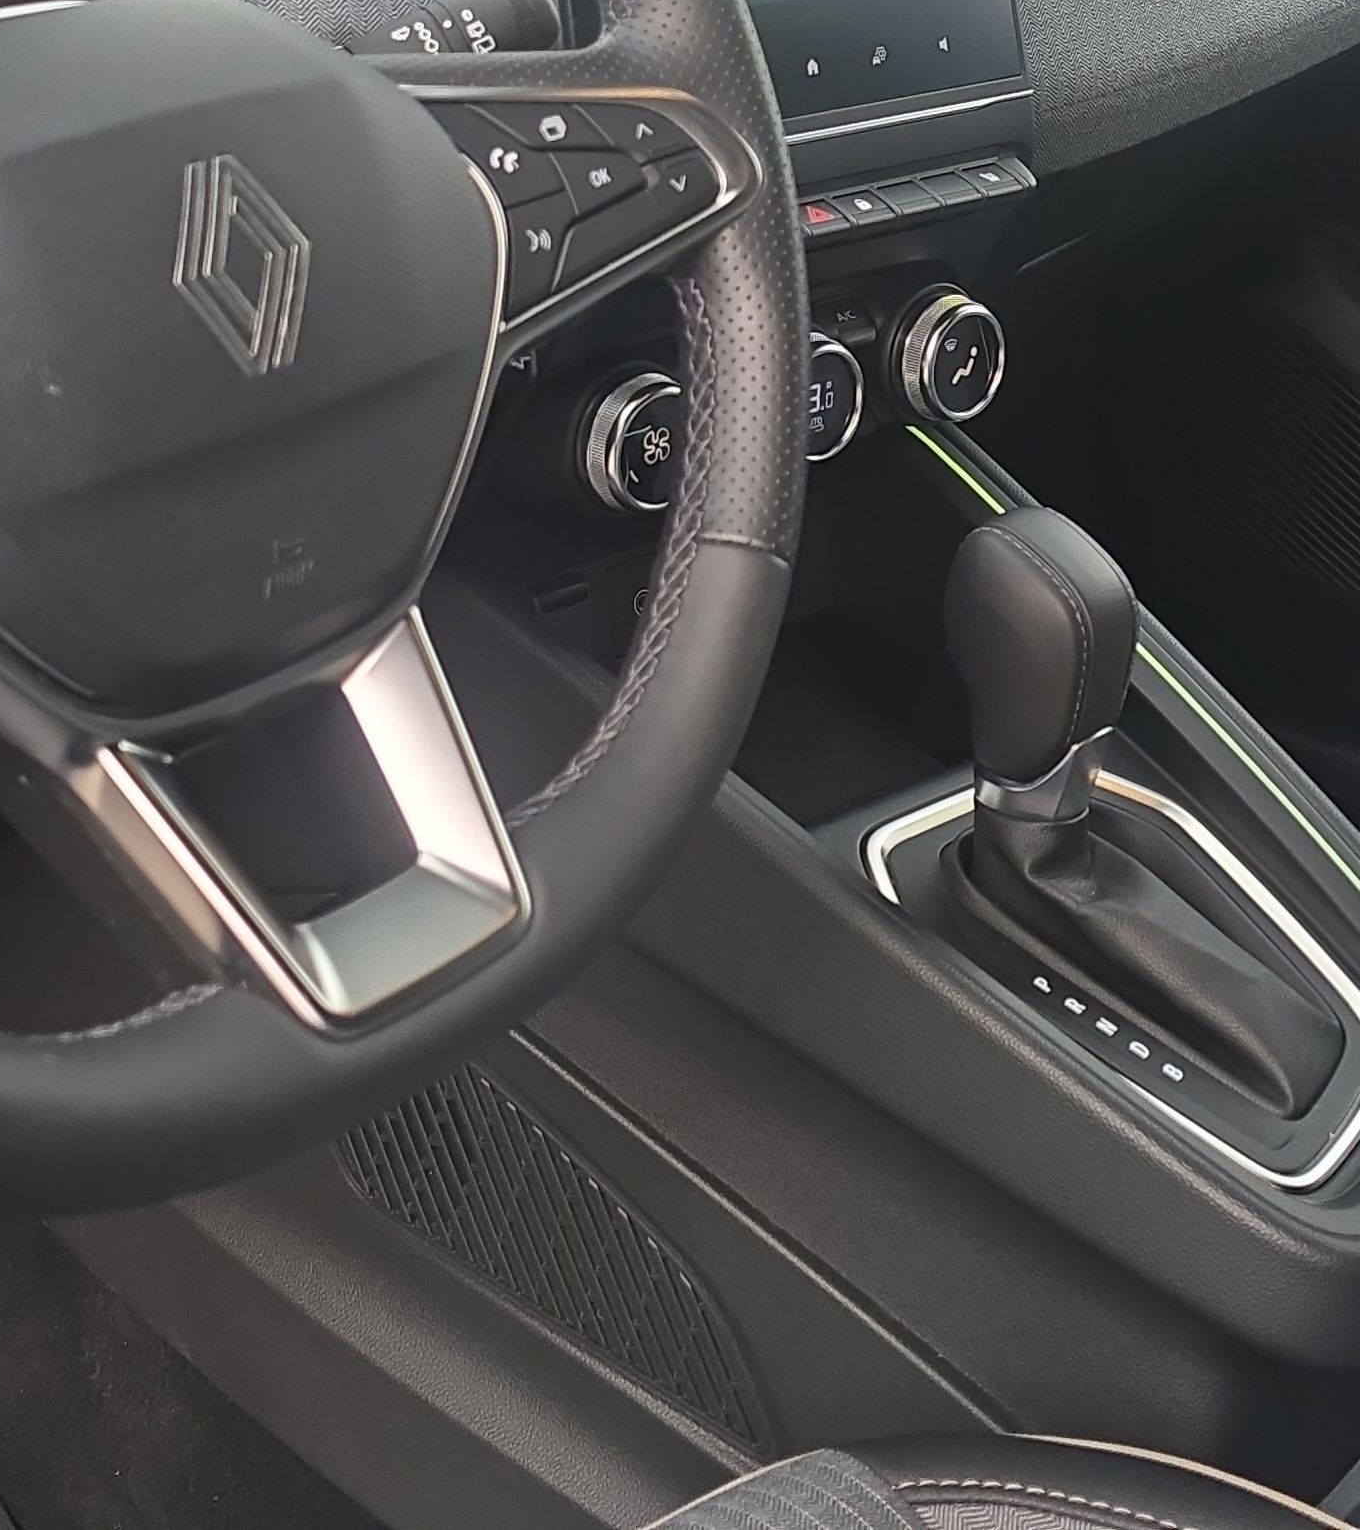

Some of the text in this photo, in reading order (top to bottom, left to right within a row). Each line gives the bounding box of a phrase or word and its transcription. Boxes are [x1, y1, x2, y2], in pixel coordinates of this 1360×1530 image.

[589, 168, 612, 188] OK
[837, 310, 857, 323] A/C
[1033, 976, 1052, 994] P
[1064, 997, 1087, 1015] R
[1095, 1017, 1119, 1037] N
[1129, 1040, 1150, 1060] D
[1162, 1063, 1184, 1081] B
